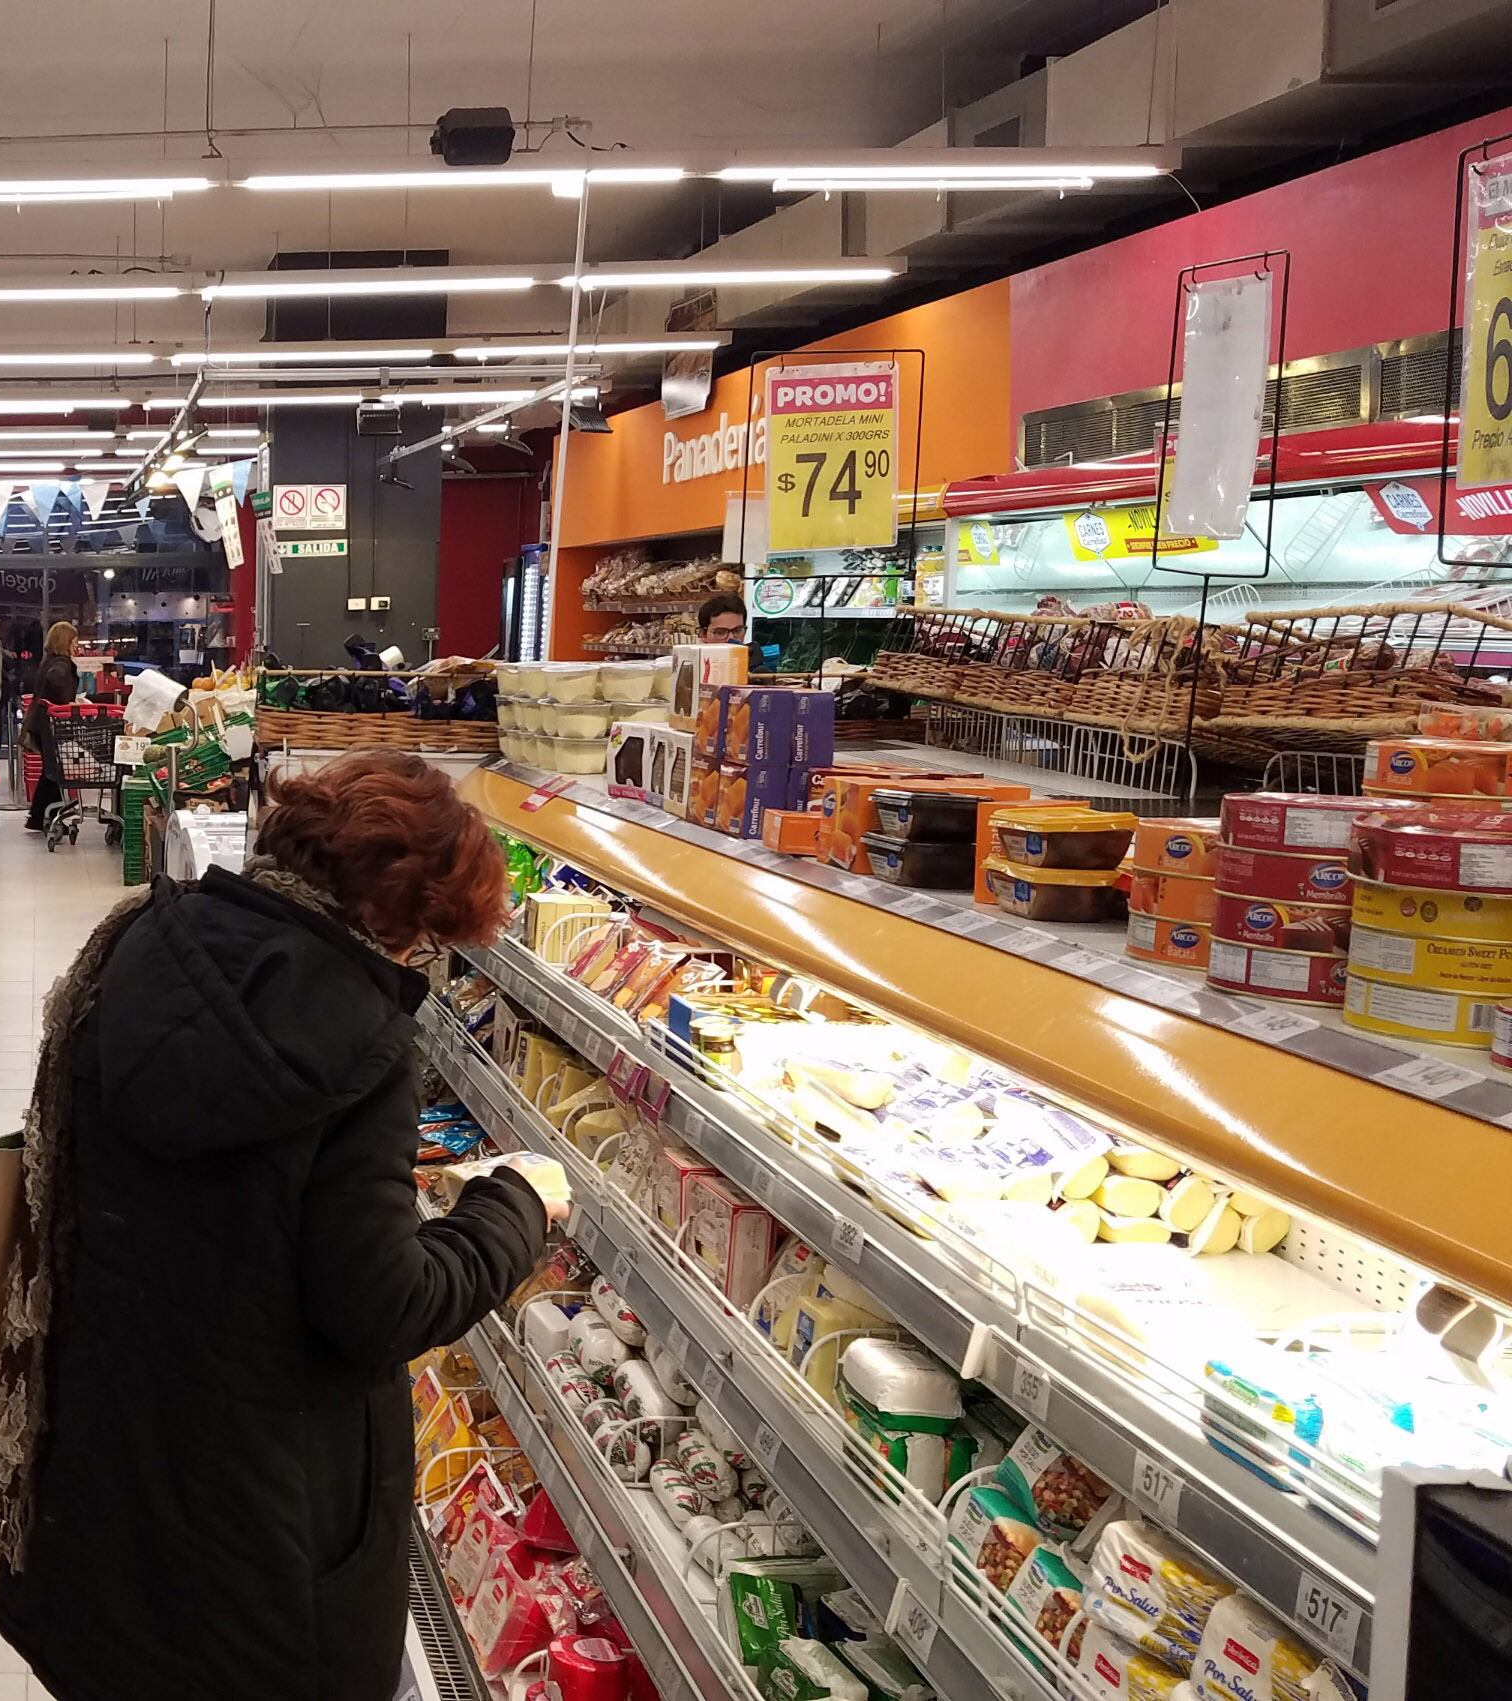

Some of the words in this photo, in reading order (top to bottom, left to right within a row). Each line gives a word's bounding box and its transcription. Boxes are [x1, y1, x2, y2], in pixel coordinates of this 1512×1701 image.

[777, 382, 886, 408] PROMO!
[785, 414, 856, 428] MORTADELA
[858, 414, 884, 425] MINI
[662, 394, 766, 485] Panadería
[780, 431, 833, 445] PALADINI
[835, 432, 843, 441] X
[845, 428, 890, 441] 300GRS
[297, 543, 338, 554] SALIDA
[754, 722, 765, 760] Carrefour
[794, 724, 805, 762] Carrefour
[748, 797, 761, 835] Carrefour
[1166, 841, 1193, 851] ARCOR
[1309, 869, 1348, 881] ARCOR
[1306, 889, 1347, 901] Membrillo
[1245, 911, 1278, 923] ARCOR
[1171, 931, 1200, 942] ARCOR
[1142, 1463, 1173, 1502] 517
[1307, 1586, 1345, 1633] 517
